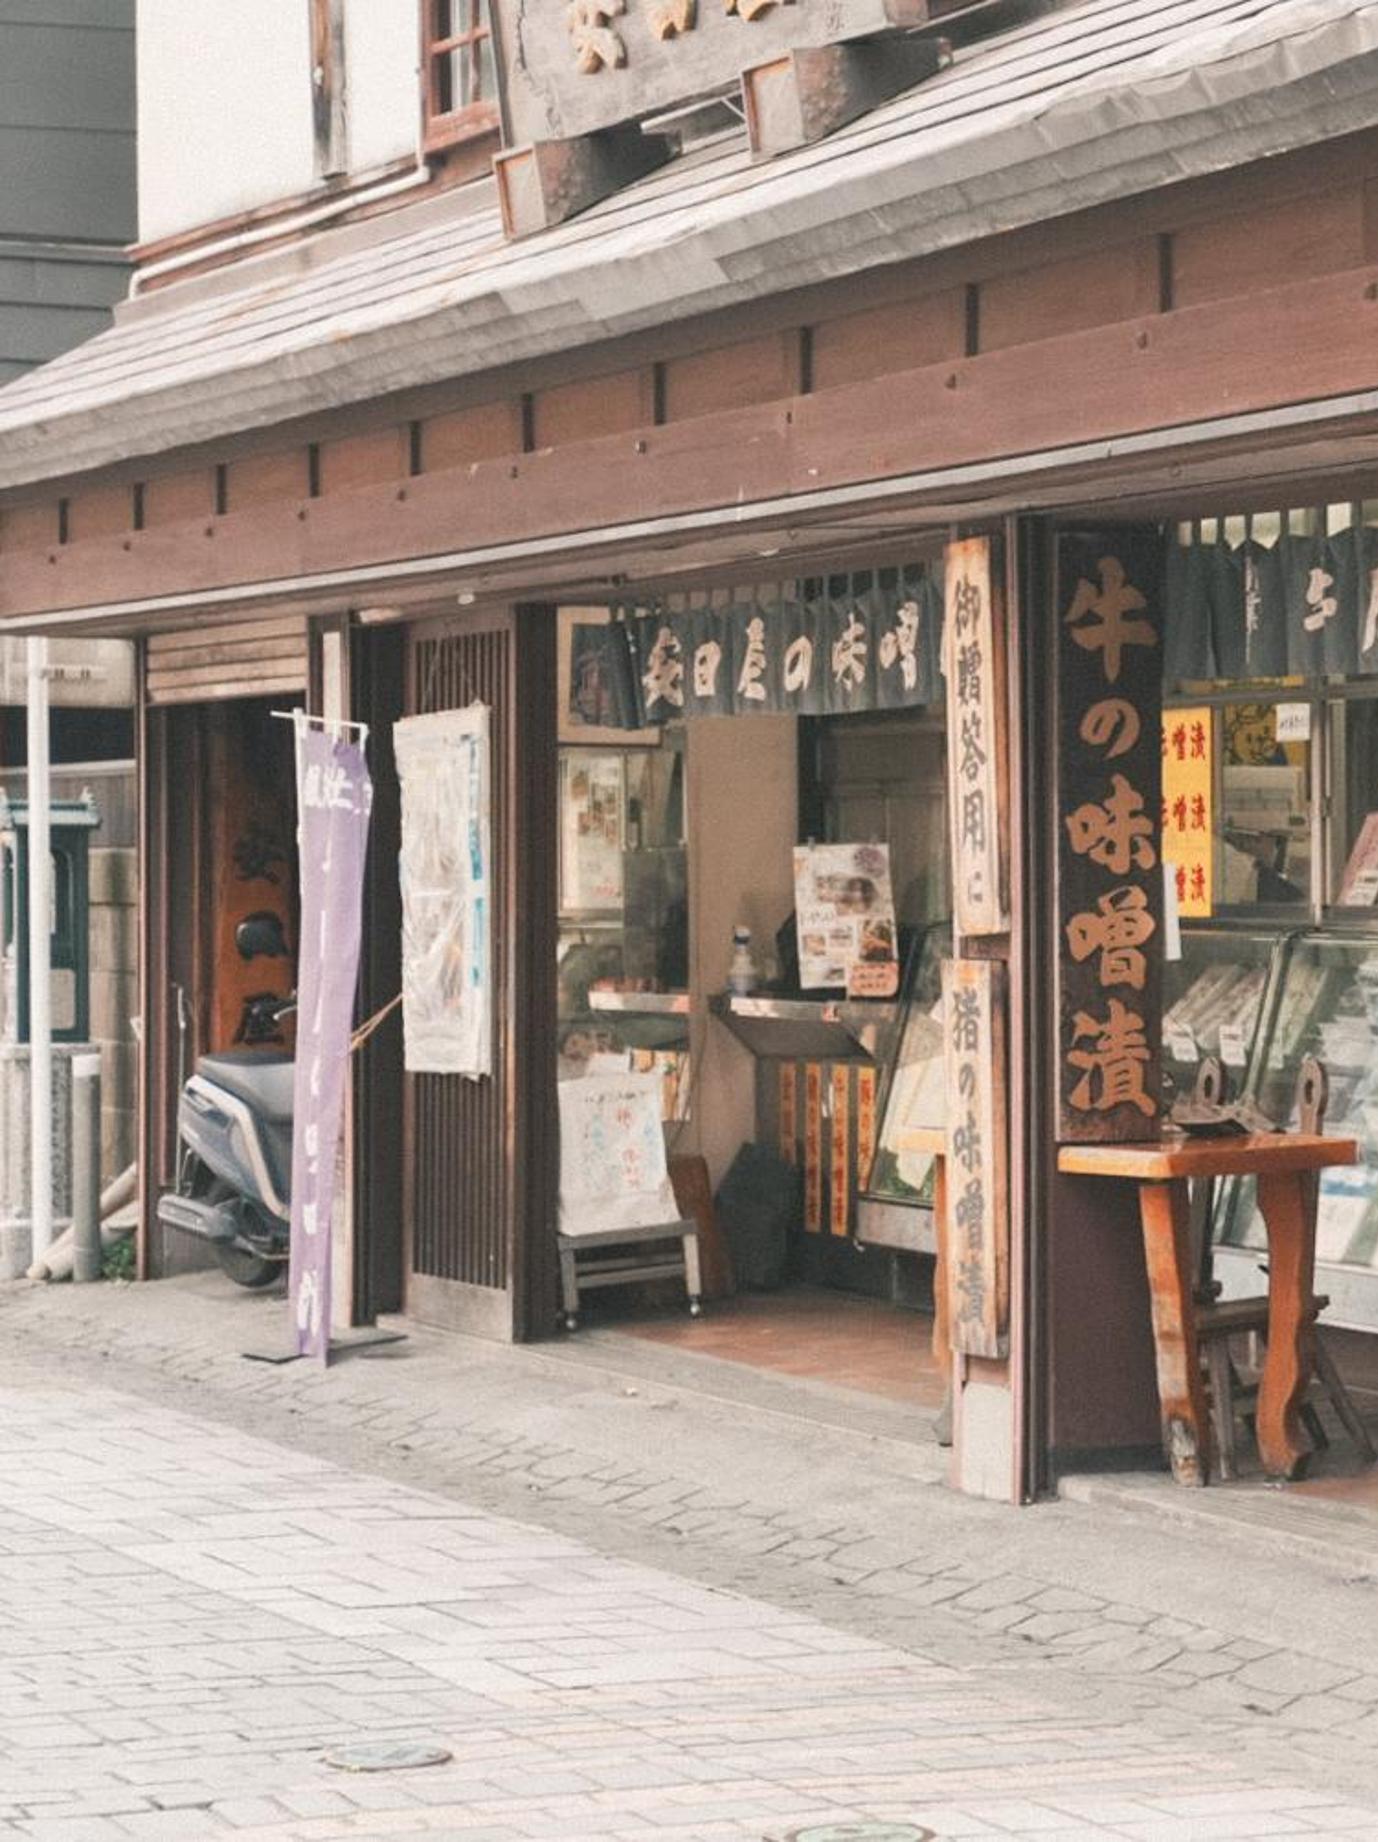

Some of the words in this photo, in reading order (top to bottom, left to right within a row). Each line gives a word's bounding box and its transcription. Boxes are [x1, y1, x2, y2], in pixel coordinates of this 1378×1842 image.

[1063, 554, 1161, 1117] 牛の味噌漬
